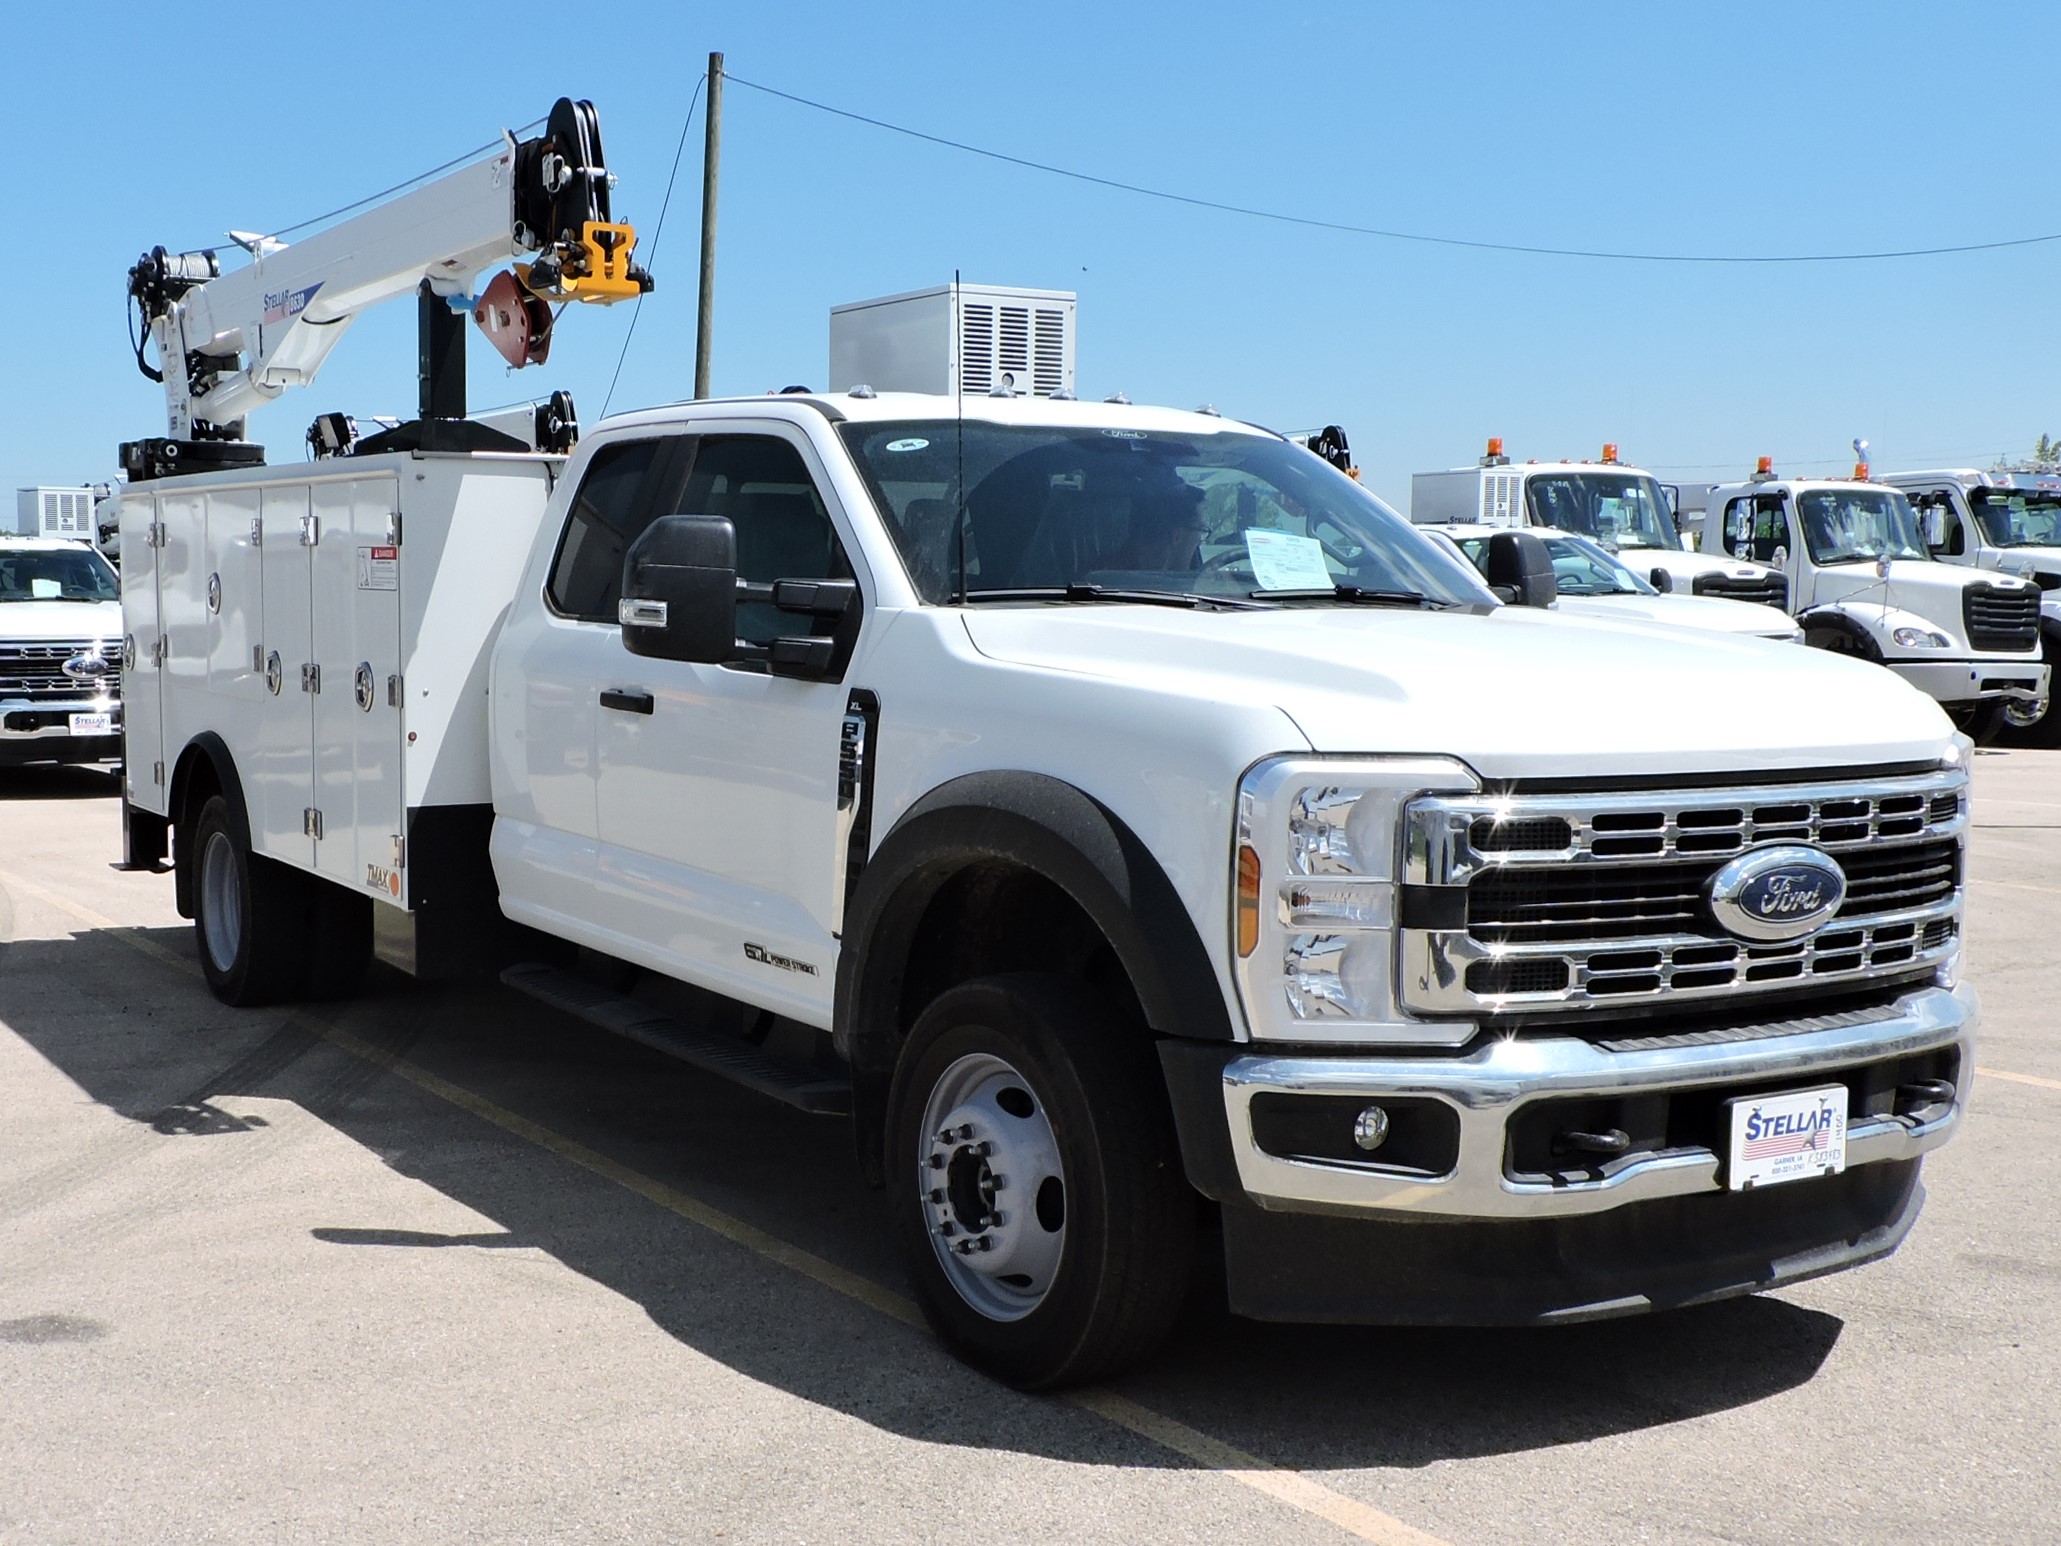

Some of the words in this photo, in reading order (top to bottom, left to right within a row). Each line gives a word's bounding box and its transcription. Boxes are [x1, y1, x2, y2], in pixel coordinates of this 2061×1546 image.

[264, 289, 289, 312] STELLAR
[850, 701, 862, 711] XL
[75, 716, 105, 724] STELLAR
[1761, 874, 1822, 914] Ford
[1745, 1108, 1832, 1141] STELLAR
